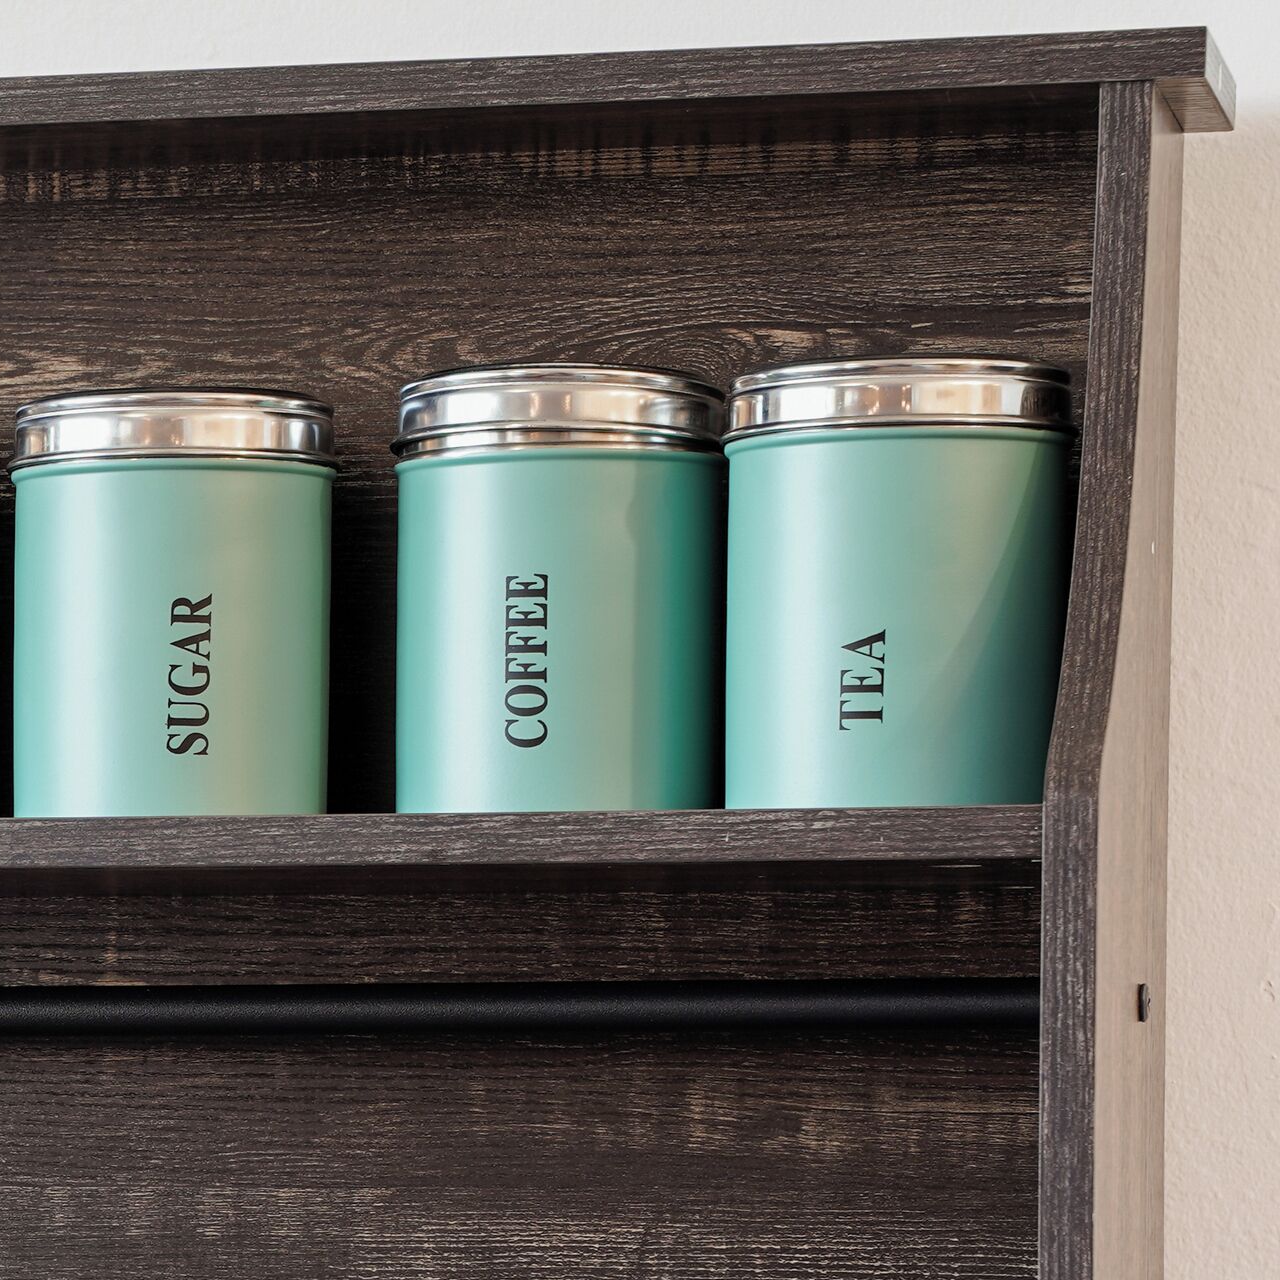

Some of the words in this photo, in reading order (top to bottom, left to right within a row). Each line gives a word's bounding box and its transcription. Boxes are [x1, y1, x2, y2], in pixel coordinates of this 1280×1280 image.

[167, 594, 212, 755] SUGAR
[505, 574, 548, 747] COFFEE
[840, 629, 885, 730] TEA
